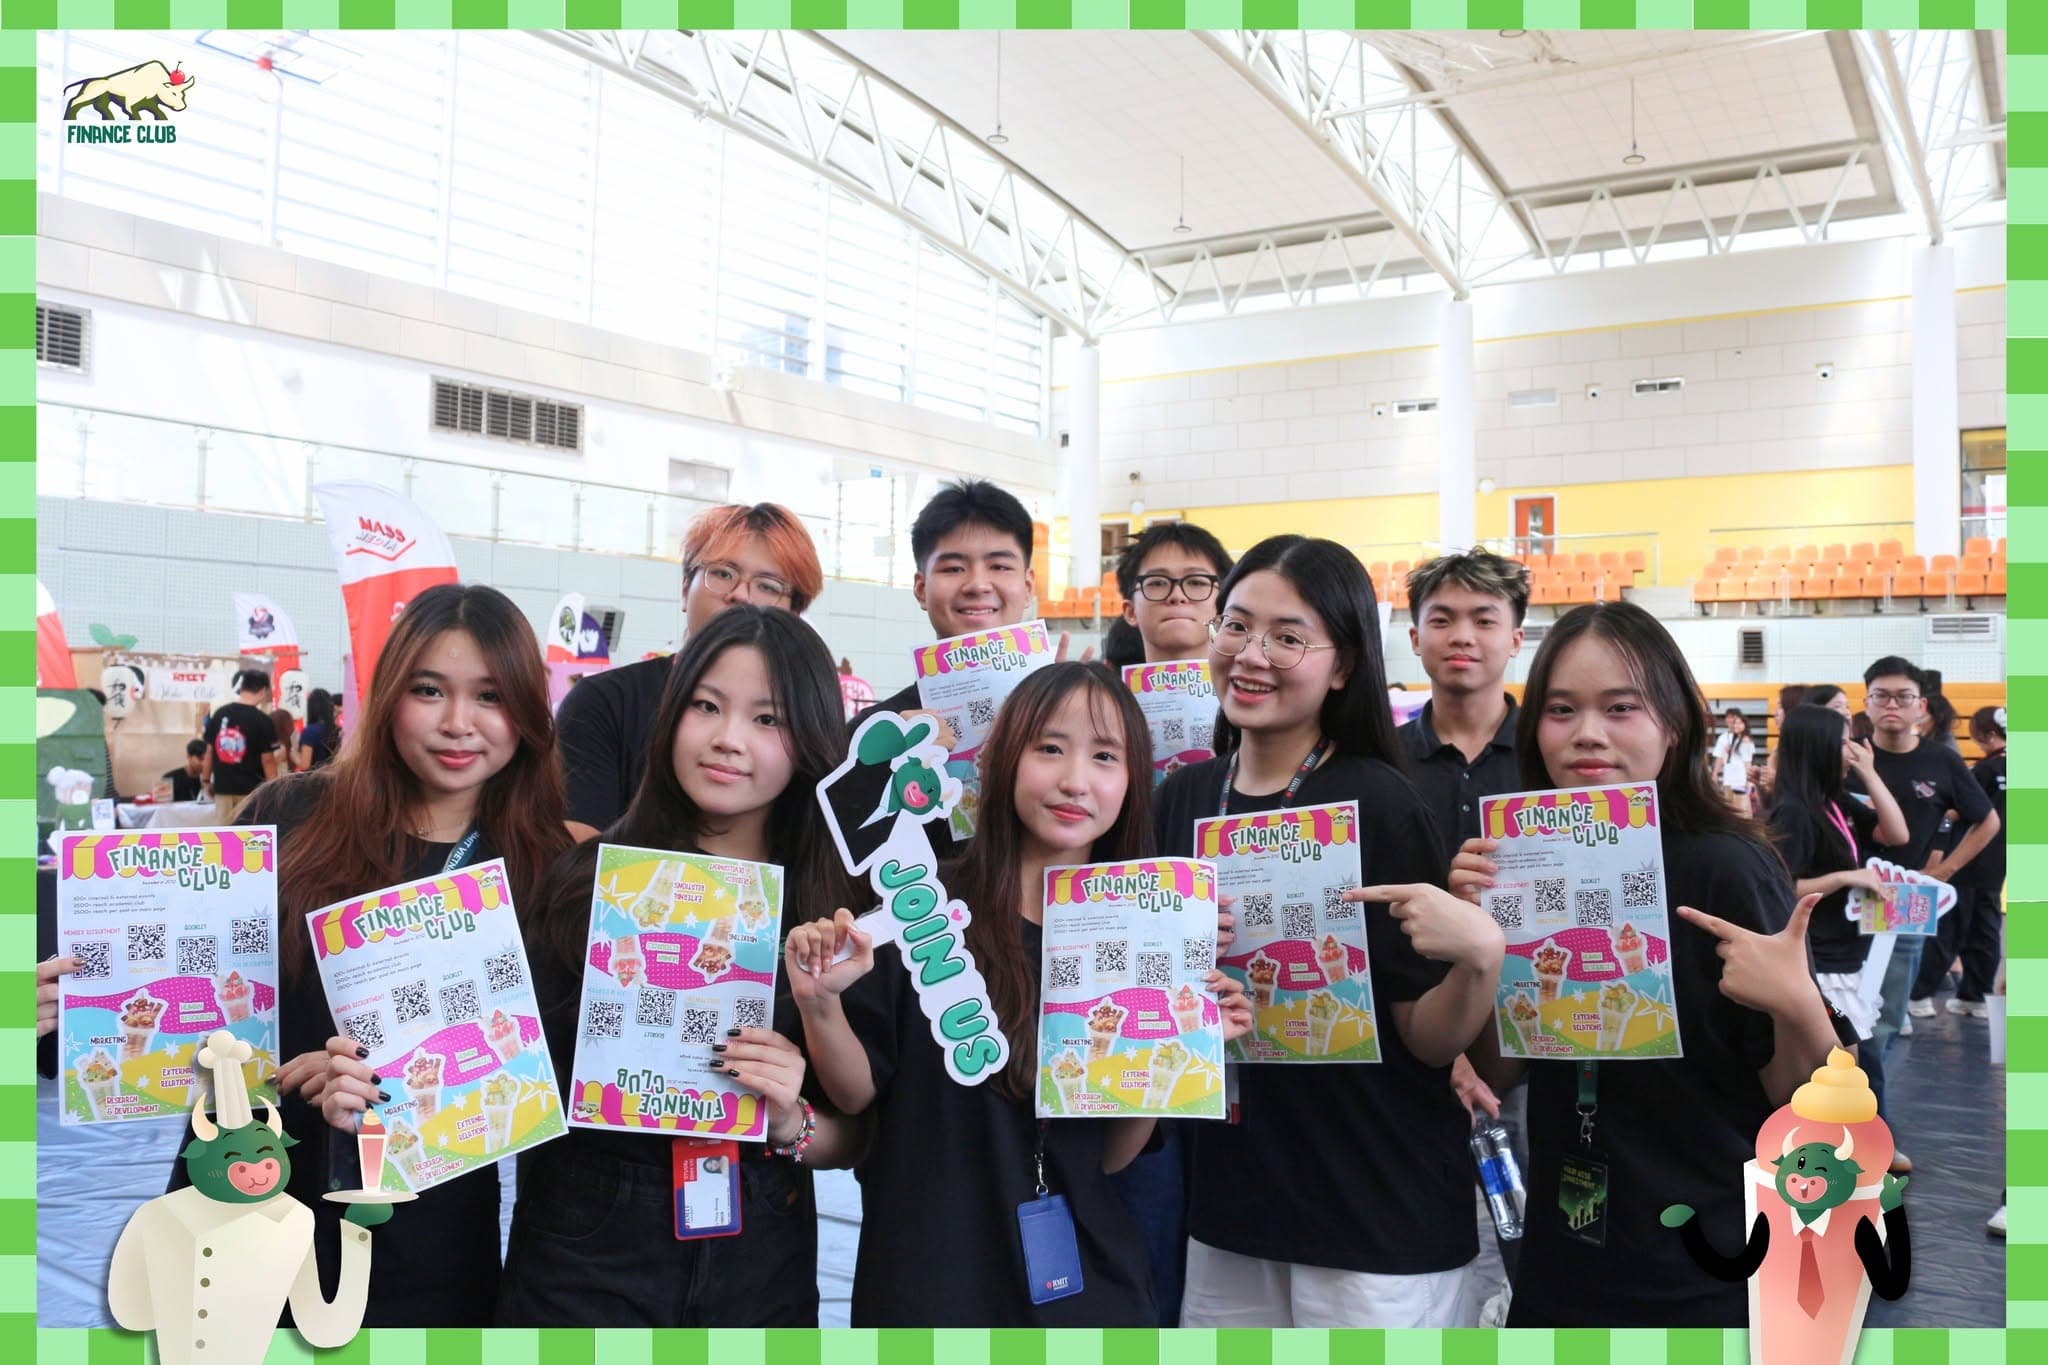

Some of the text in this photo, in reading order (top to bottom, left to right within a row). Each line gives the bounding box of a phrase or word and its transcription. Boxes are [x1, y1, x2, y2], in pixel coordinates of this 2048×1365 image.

[357, 515, 406, 543] MASS
[945, 640, 1006, 667] FINANCE
[991, 652, 1028, 672] CLUB
[1149, 669, 1202, 688] FINANCE
[1515, 803, 1593, 831] FINANCE
[1230, 823, 1301, 850] FINANCE
[1572, 821, 1619, 847] CLUB
[109, 843, 204, 872] FINANCE
[447, 847, 467, 872] VIETN
[1280, 840, 1322, 864] CLUB
[177, 864, 231, 892] CLUB
[1083, 872, 1160, 897] FINANCE
[1138, 889, 1183, 913] CLUB
[353, 895, 444, 938] FINANCE
[424, 911, 476, 940] CLUB
[879, 859, 1000, 1076] JOIN US
[616, 1068, 664, 1094] CLUB
[639, 1092, 725, 1120] FINANCE
